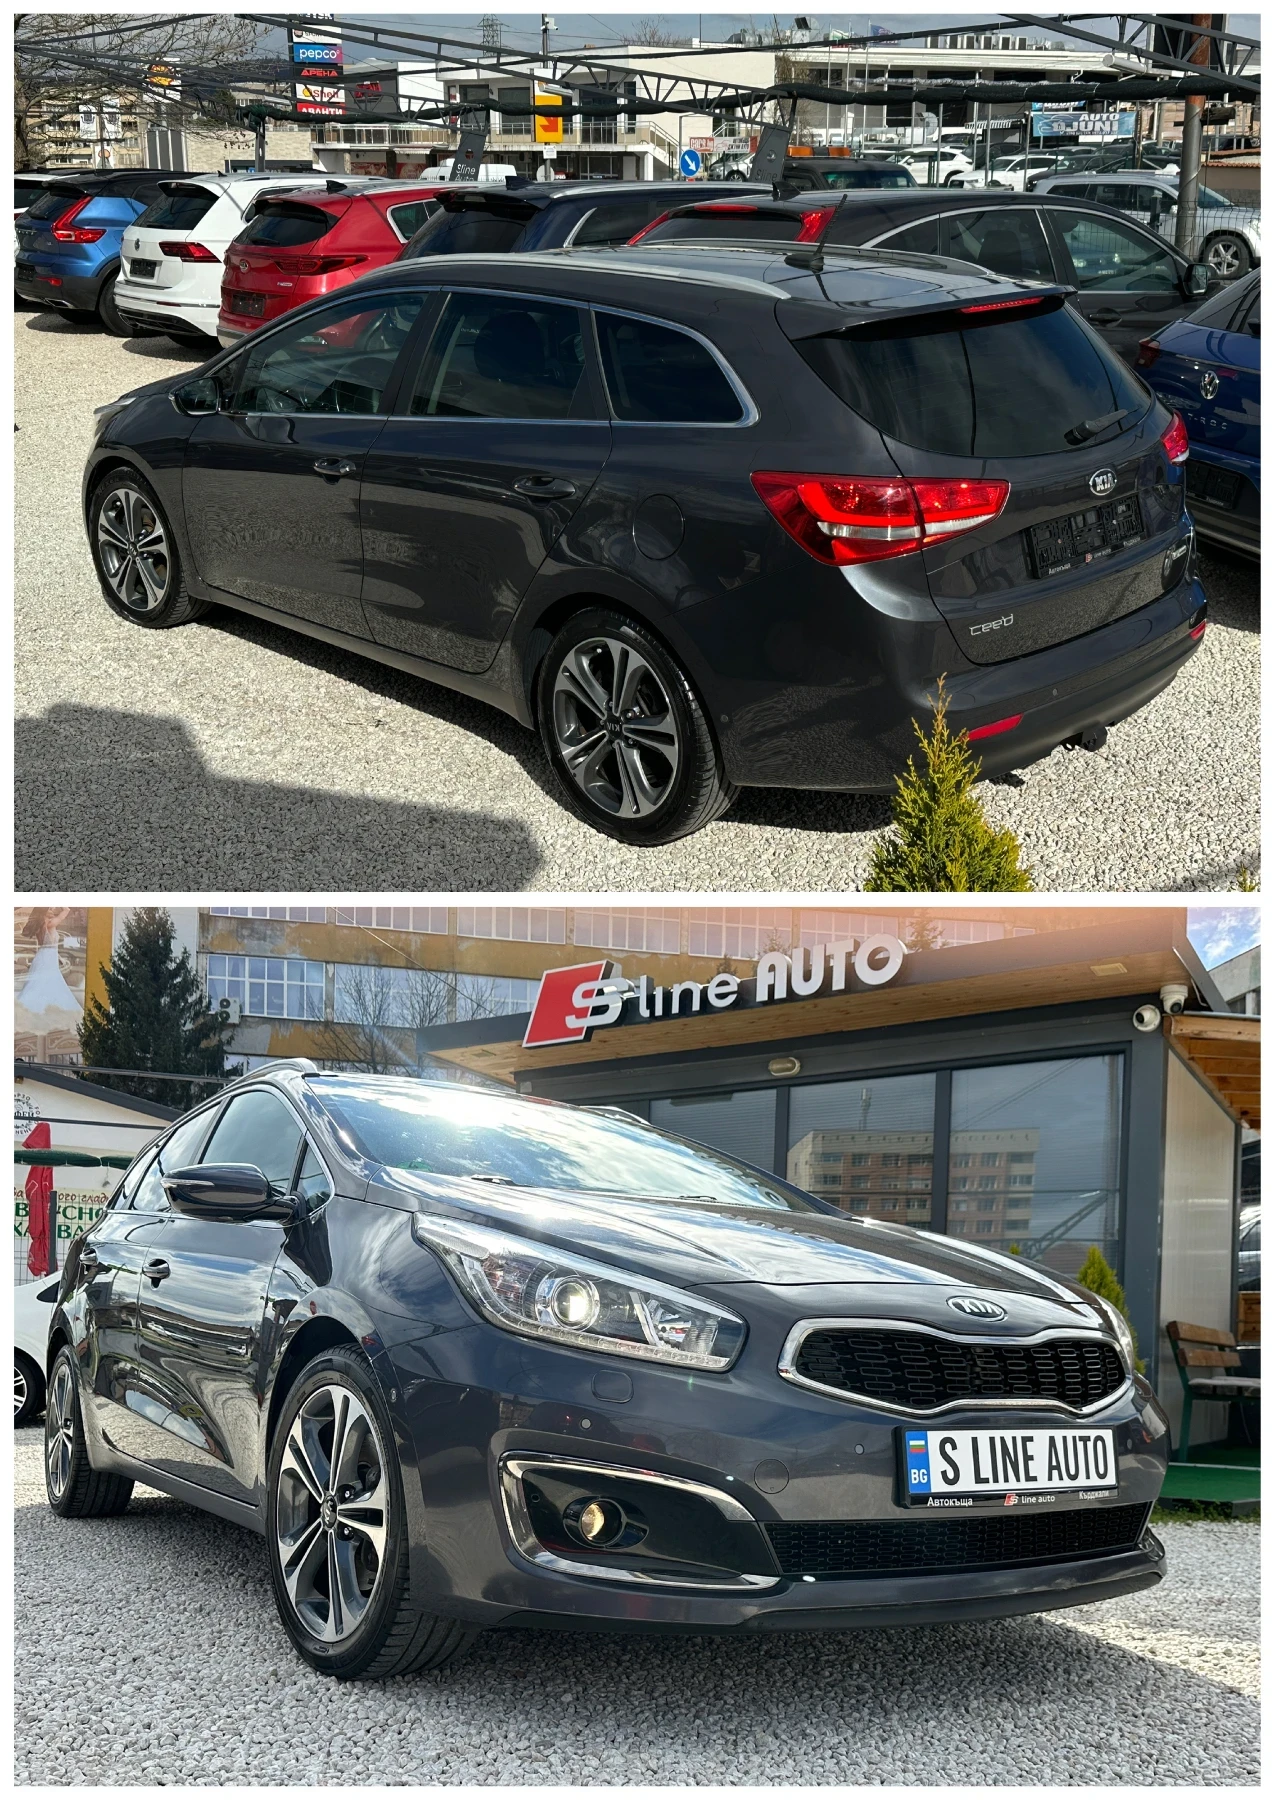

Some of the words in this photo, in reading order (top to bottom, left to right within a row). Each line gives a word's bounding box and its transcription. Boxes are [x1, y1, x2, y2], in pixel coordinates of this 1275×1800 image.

[300, 49, 337, 59] pepco
[1079, 113, 1119, 121] AUTO
[1093, 470, 1117, 492] KIA
[638, 973, 739, 1018] line
[756, 933, 905, 1003] AUTO
[953, 1298, 1002, 1317] KIA
[938, 1436, 961, 1486] S
[971, 1435, 1038, 1485] LINE
[1047, 1434, 1109, 1482] AUTO
[911, 1469, 928, 1484] BG
[927, 1496, 973, 1507] Автокъща
[1021, 1495, 1037, 1504] line
[1038, 1494, 1055, 1503] auto
